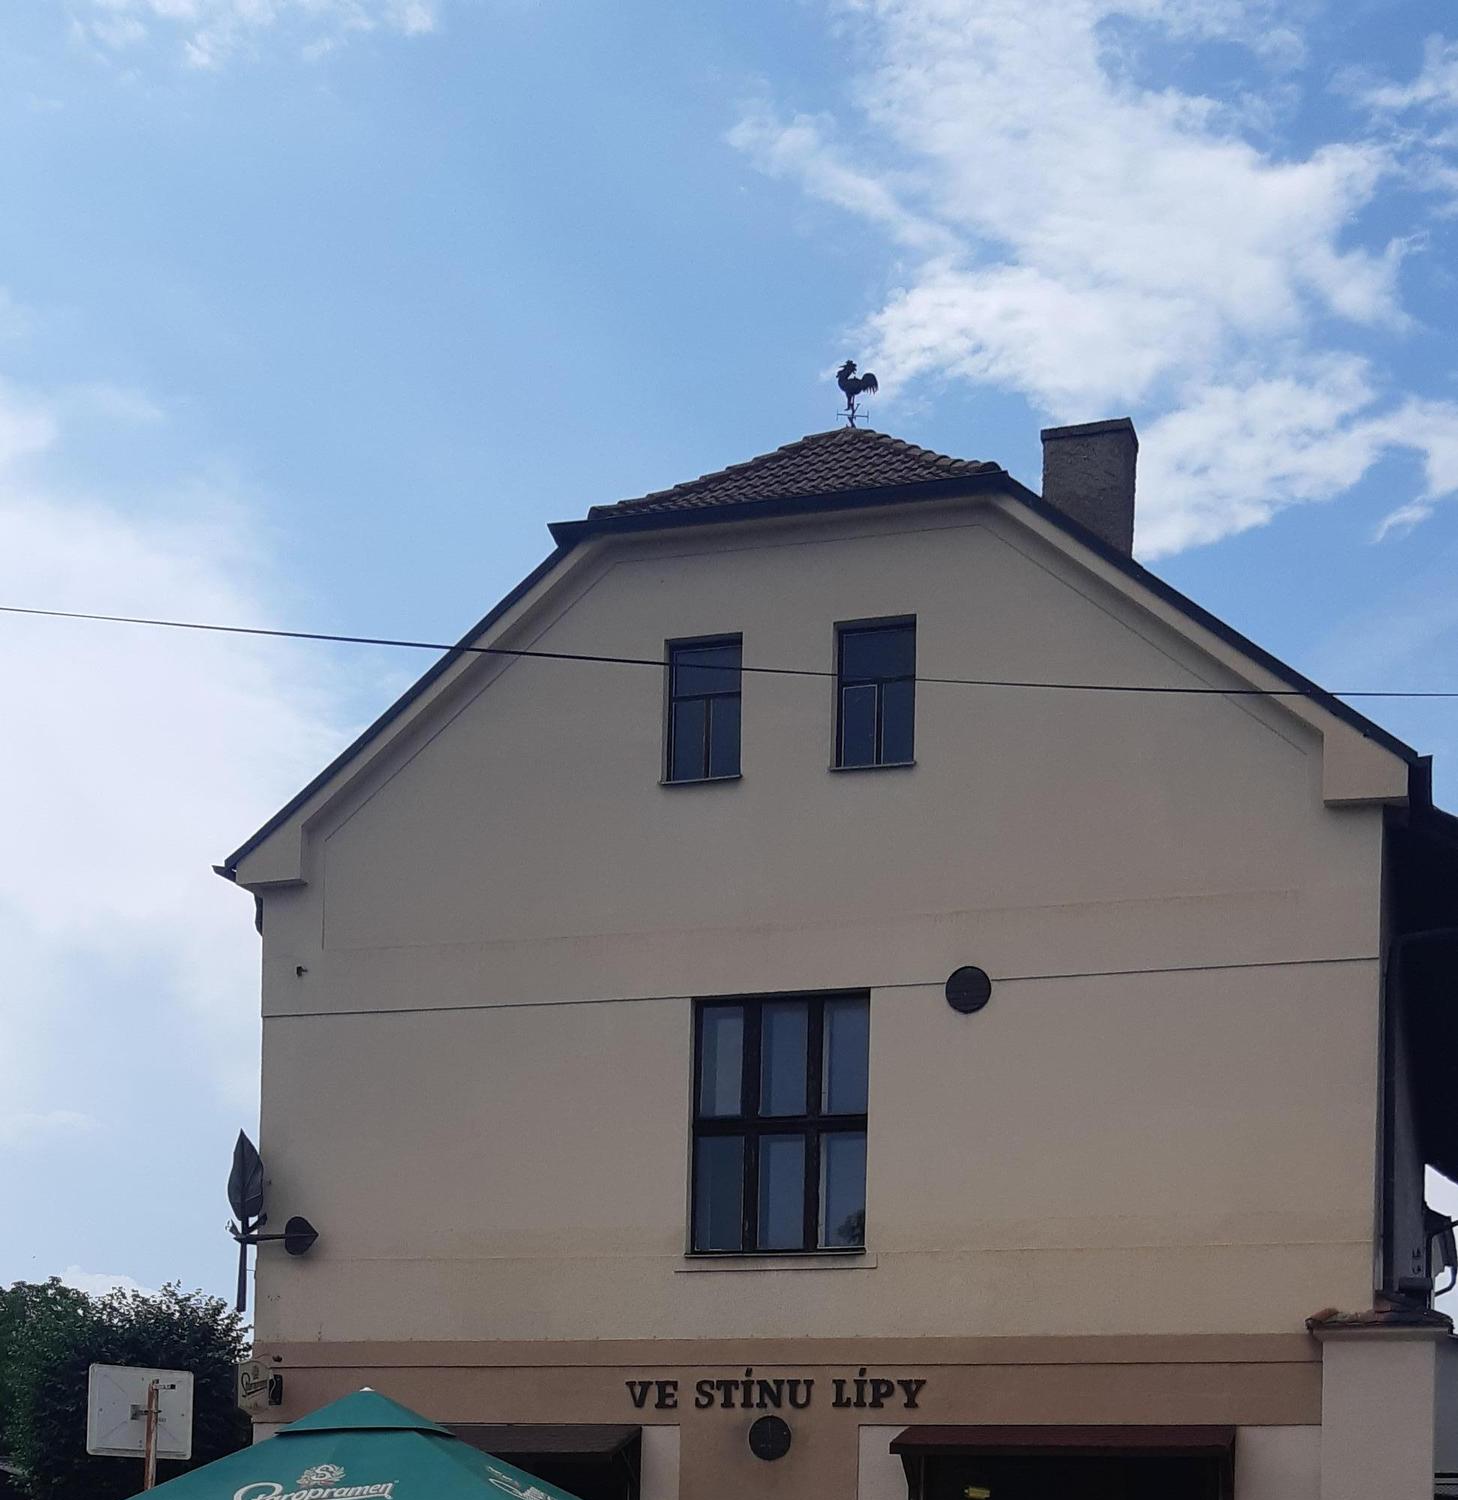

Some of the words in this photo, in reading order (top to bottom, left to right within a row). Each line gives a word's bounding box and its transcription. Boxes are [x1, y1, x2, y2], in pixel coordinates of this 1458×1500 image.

[625, 1380, 678, 1409] VE
[695, 1368, 815, 1409] STÍNU
[832, 1367, 927, 1408] LÍPY
